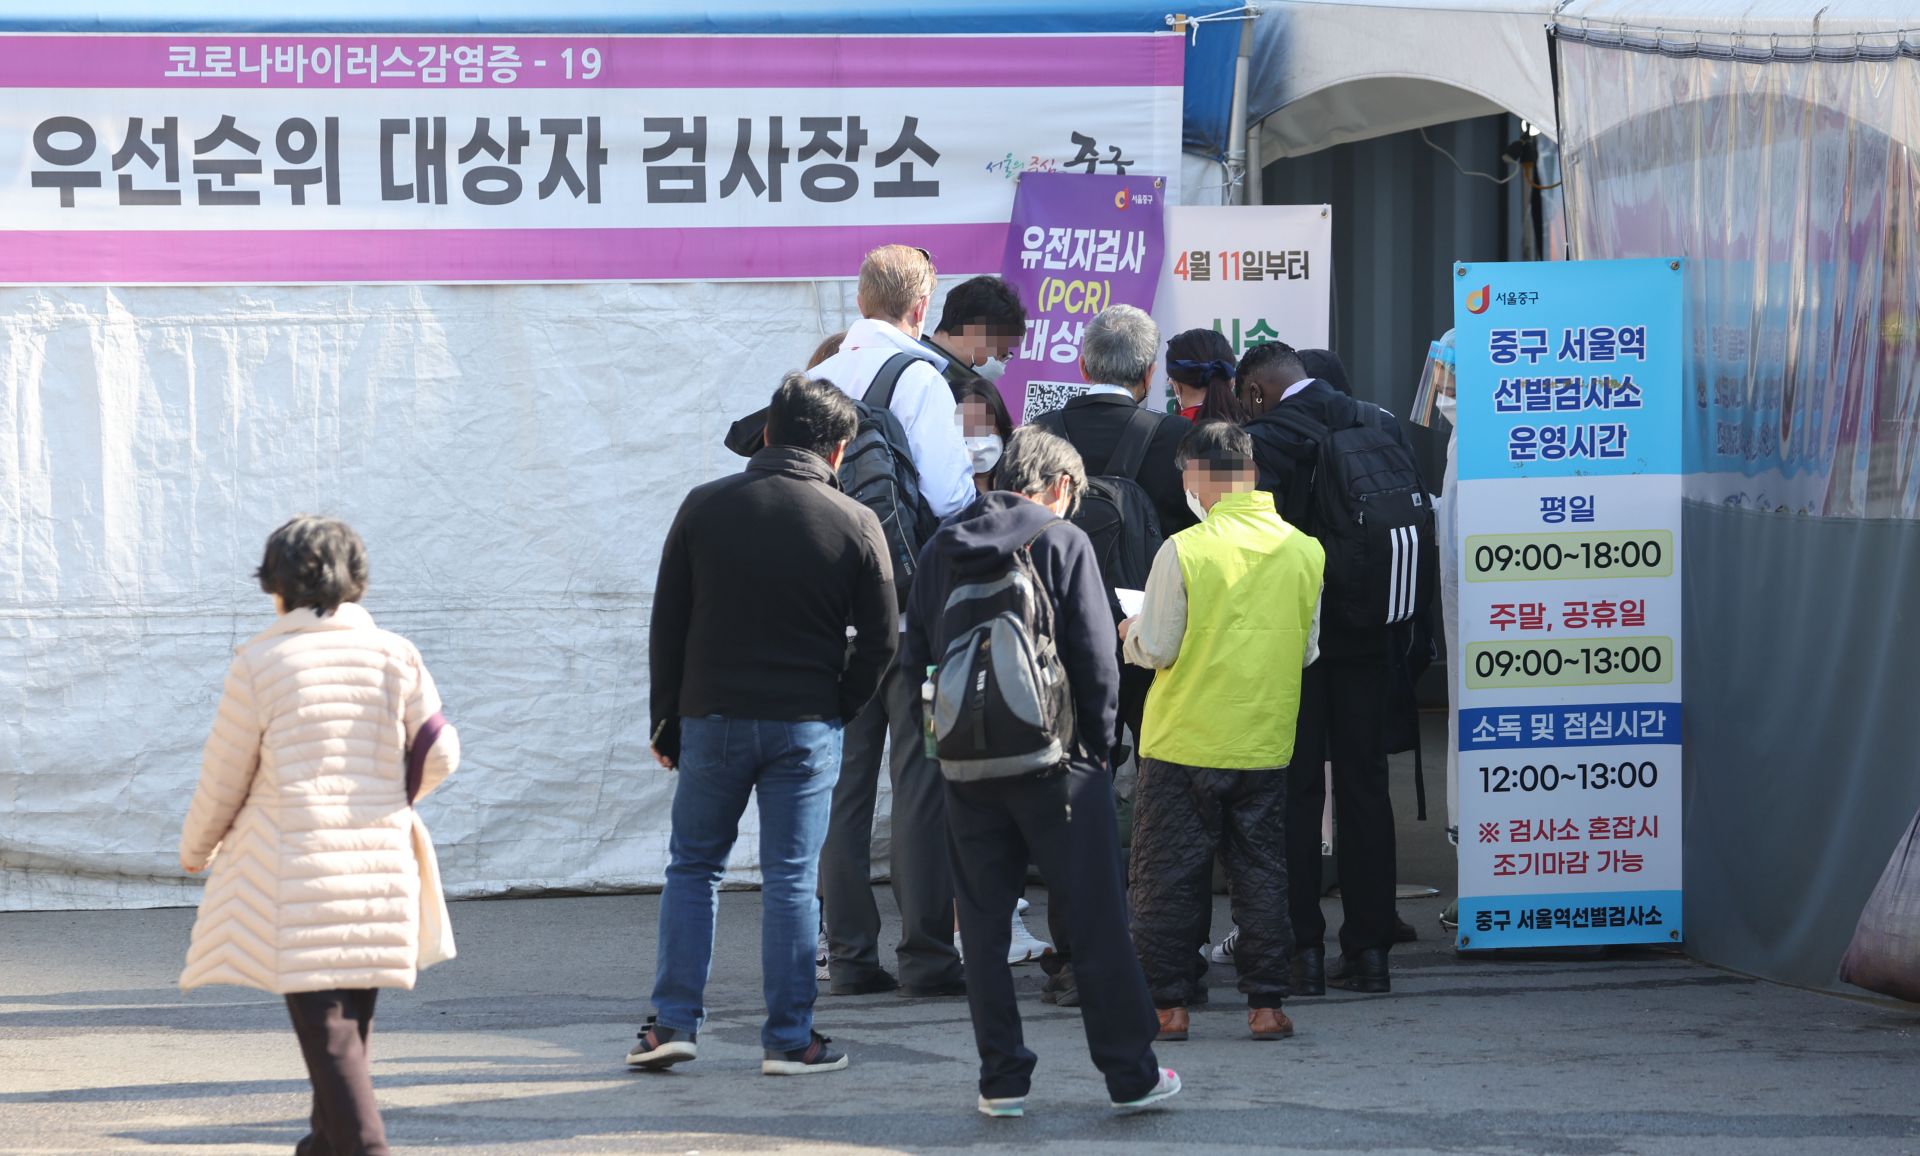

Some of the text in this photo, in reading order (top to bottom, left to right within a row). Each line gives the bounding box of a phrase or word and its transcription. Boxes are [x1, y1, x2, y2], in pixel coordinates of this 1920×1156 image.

[164, 45, 522, 83] 코로나바이러스감염증
[560, 47, 601, 80] 19
[31, 114, 941, 208] 우선순위 대상자 검사장소
[1020, 225, 1146, 274] 유전자검사
[1173, 249, 1310, 281] 4월 11일부터
[1038, 276, 1110, 314] (PCR)
[1495, 291, 1540, 306] 서울중구
[1490, 325, 1647, 364] 중구 서울역
[1494, 375, 1643, 413] 선별검사소
[1508, 423, 1628, 461] 운영시간
[1540, 495, 1595, 523] 평일
[1475, 540, 1661, 572] 09:00~18:00
[1489, 599, 1646, 632] 주말, 공휴일
[1475, 645, 1662, 678] 09:00~13:00
[1471, 710, 1667, 743] 소독 및 점심시간
[1478, 761, 1658, 793] 12:00~13:00
[1508, 818, 1580, 842] 검사소
[1588, 815, 1659, 840] 혼잡시
[1493, 849, 1644, 876] 조기마감 가능
[1474, 905, 1663, 931] 중구 서울역선별검사소
